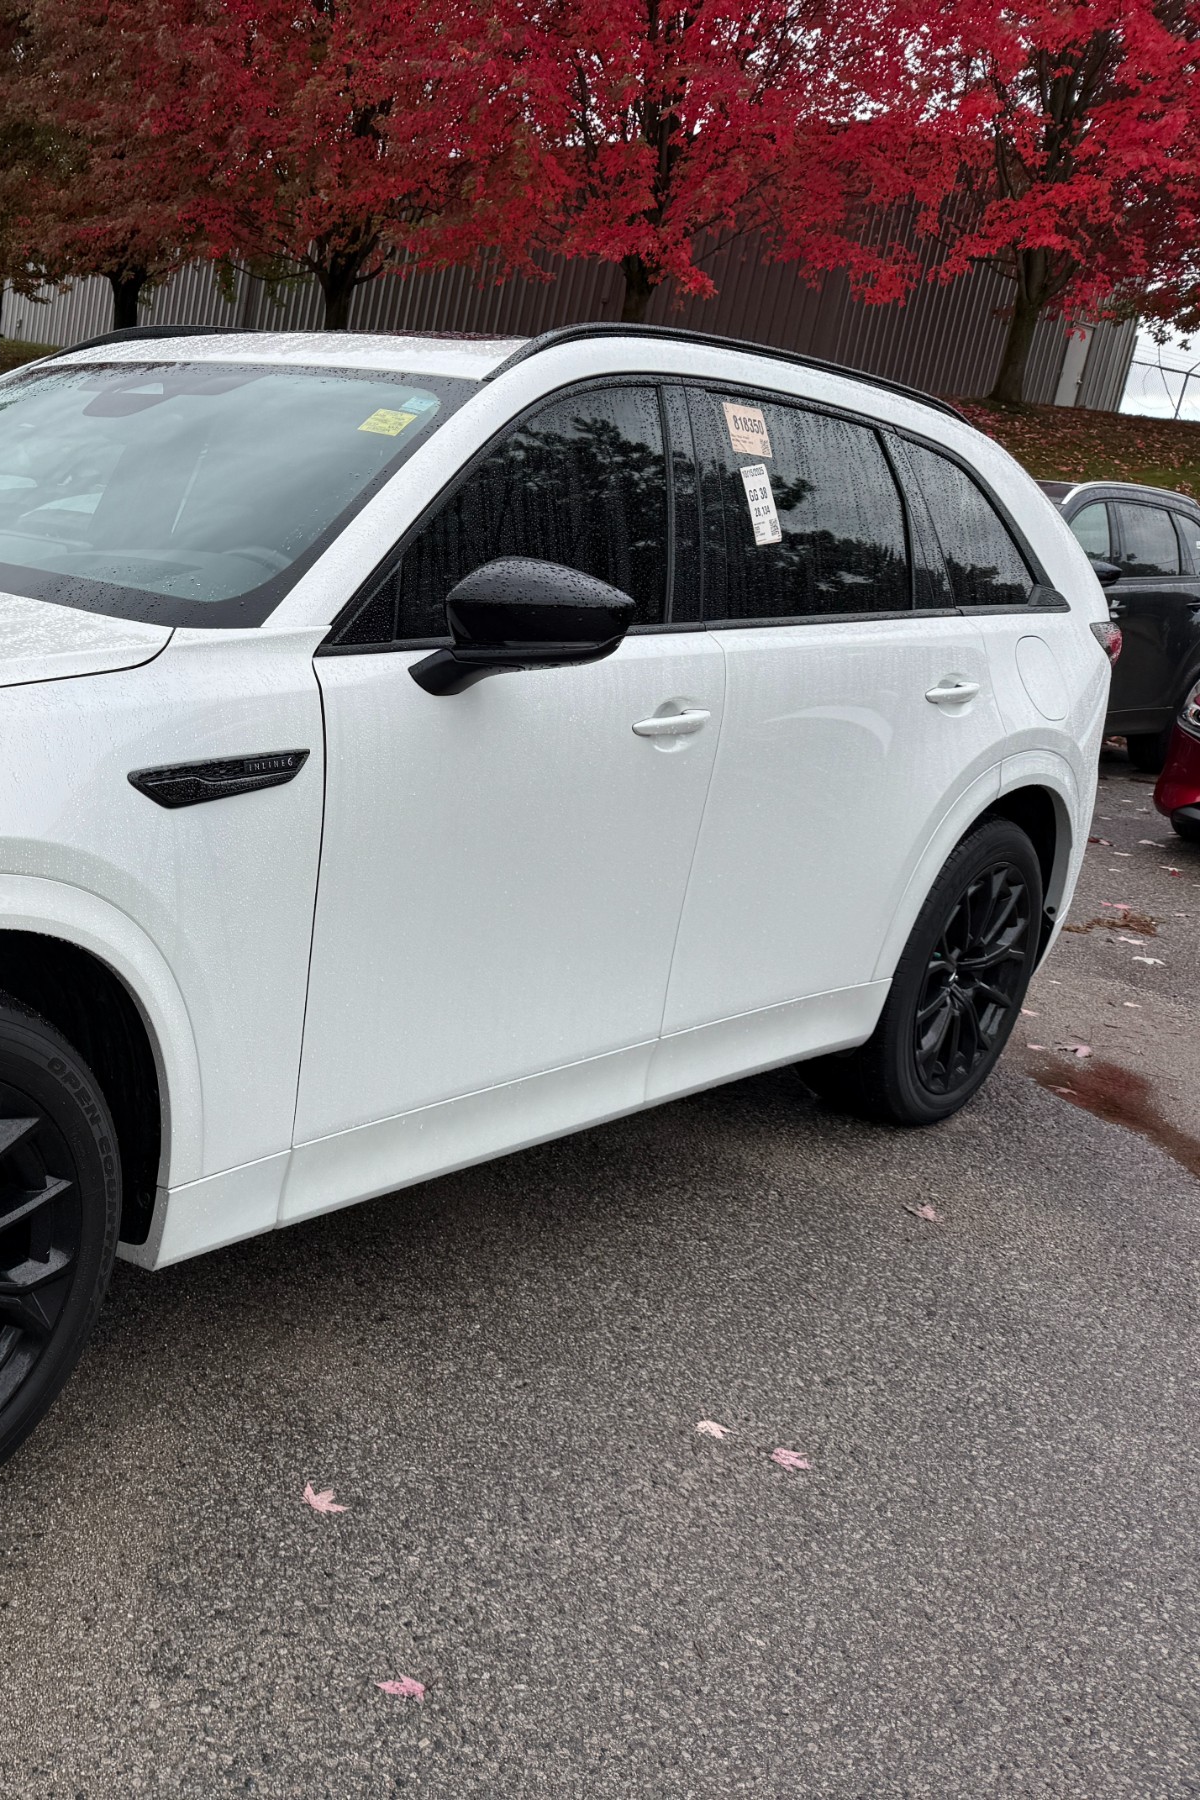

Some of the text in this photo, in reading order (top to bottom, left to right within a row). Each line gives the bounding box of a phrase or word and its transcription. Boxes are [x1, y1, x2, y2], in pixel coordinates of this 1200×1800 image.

[733, 414, 764, 435] 818350
[748, 486, 768, 502] GG 38
[47, 1056, 101, 1127] OPEN
